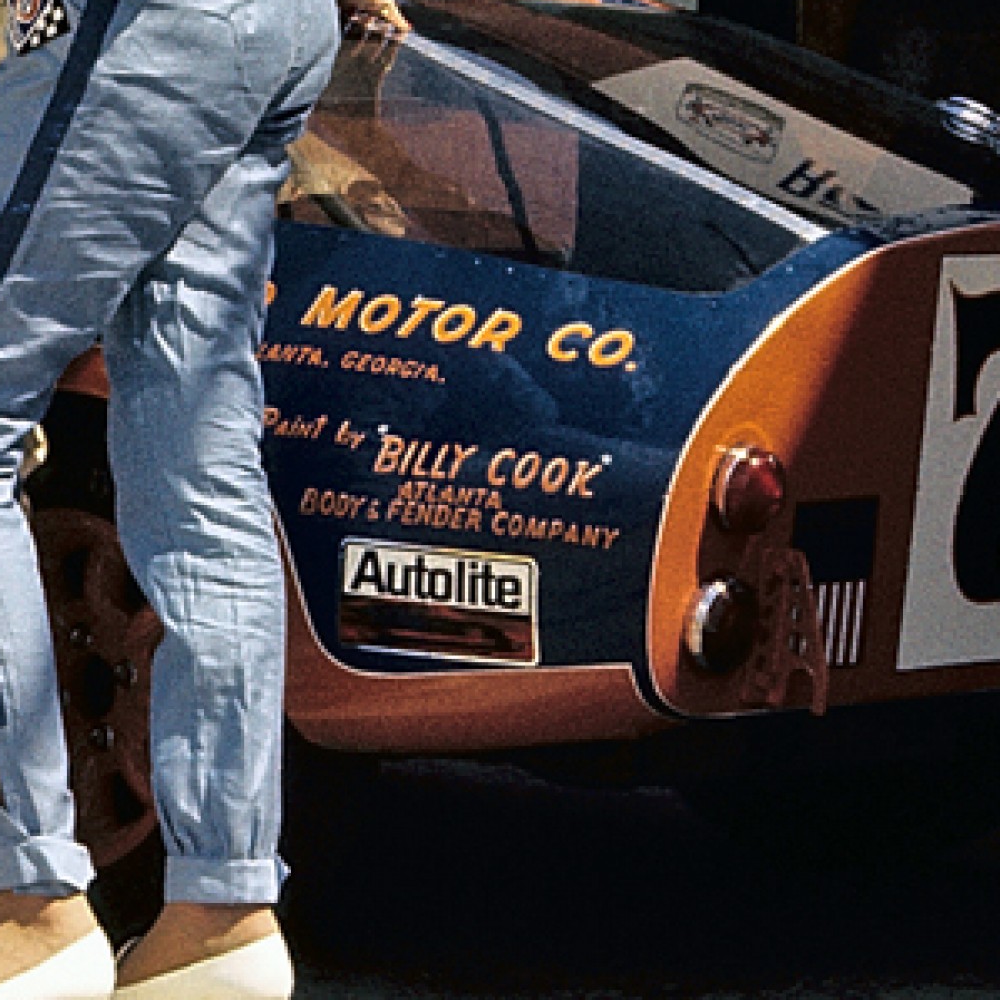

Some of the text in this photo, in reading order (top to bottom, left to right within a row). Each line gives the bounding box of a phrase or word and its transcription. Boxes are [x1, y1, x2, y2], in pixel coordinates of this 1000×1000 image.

[300, 284, 523, 351] MOTOR
[545, 322, 637, 371] CO.
[264, 407, 328, 439] Paint
[334, 419, 365, 449] by
[299, 488, 366, 521] BODY
[387, 497, 482, 533] FENDER
[491, 510, 620, 549] COMPANY
[350, 551, 522, 609] Autolite
